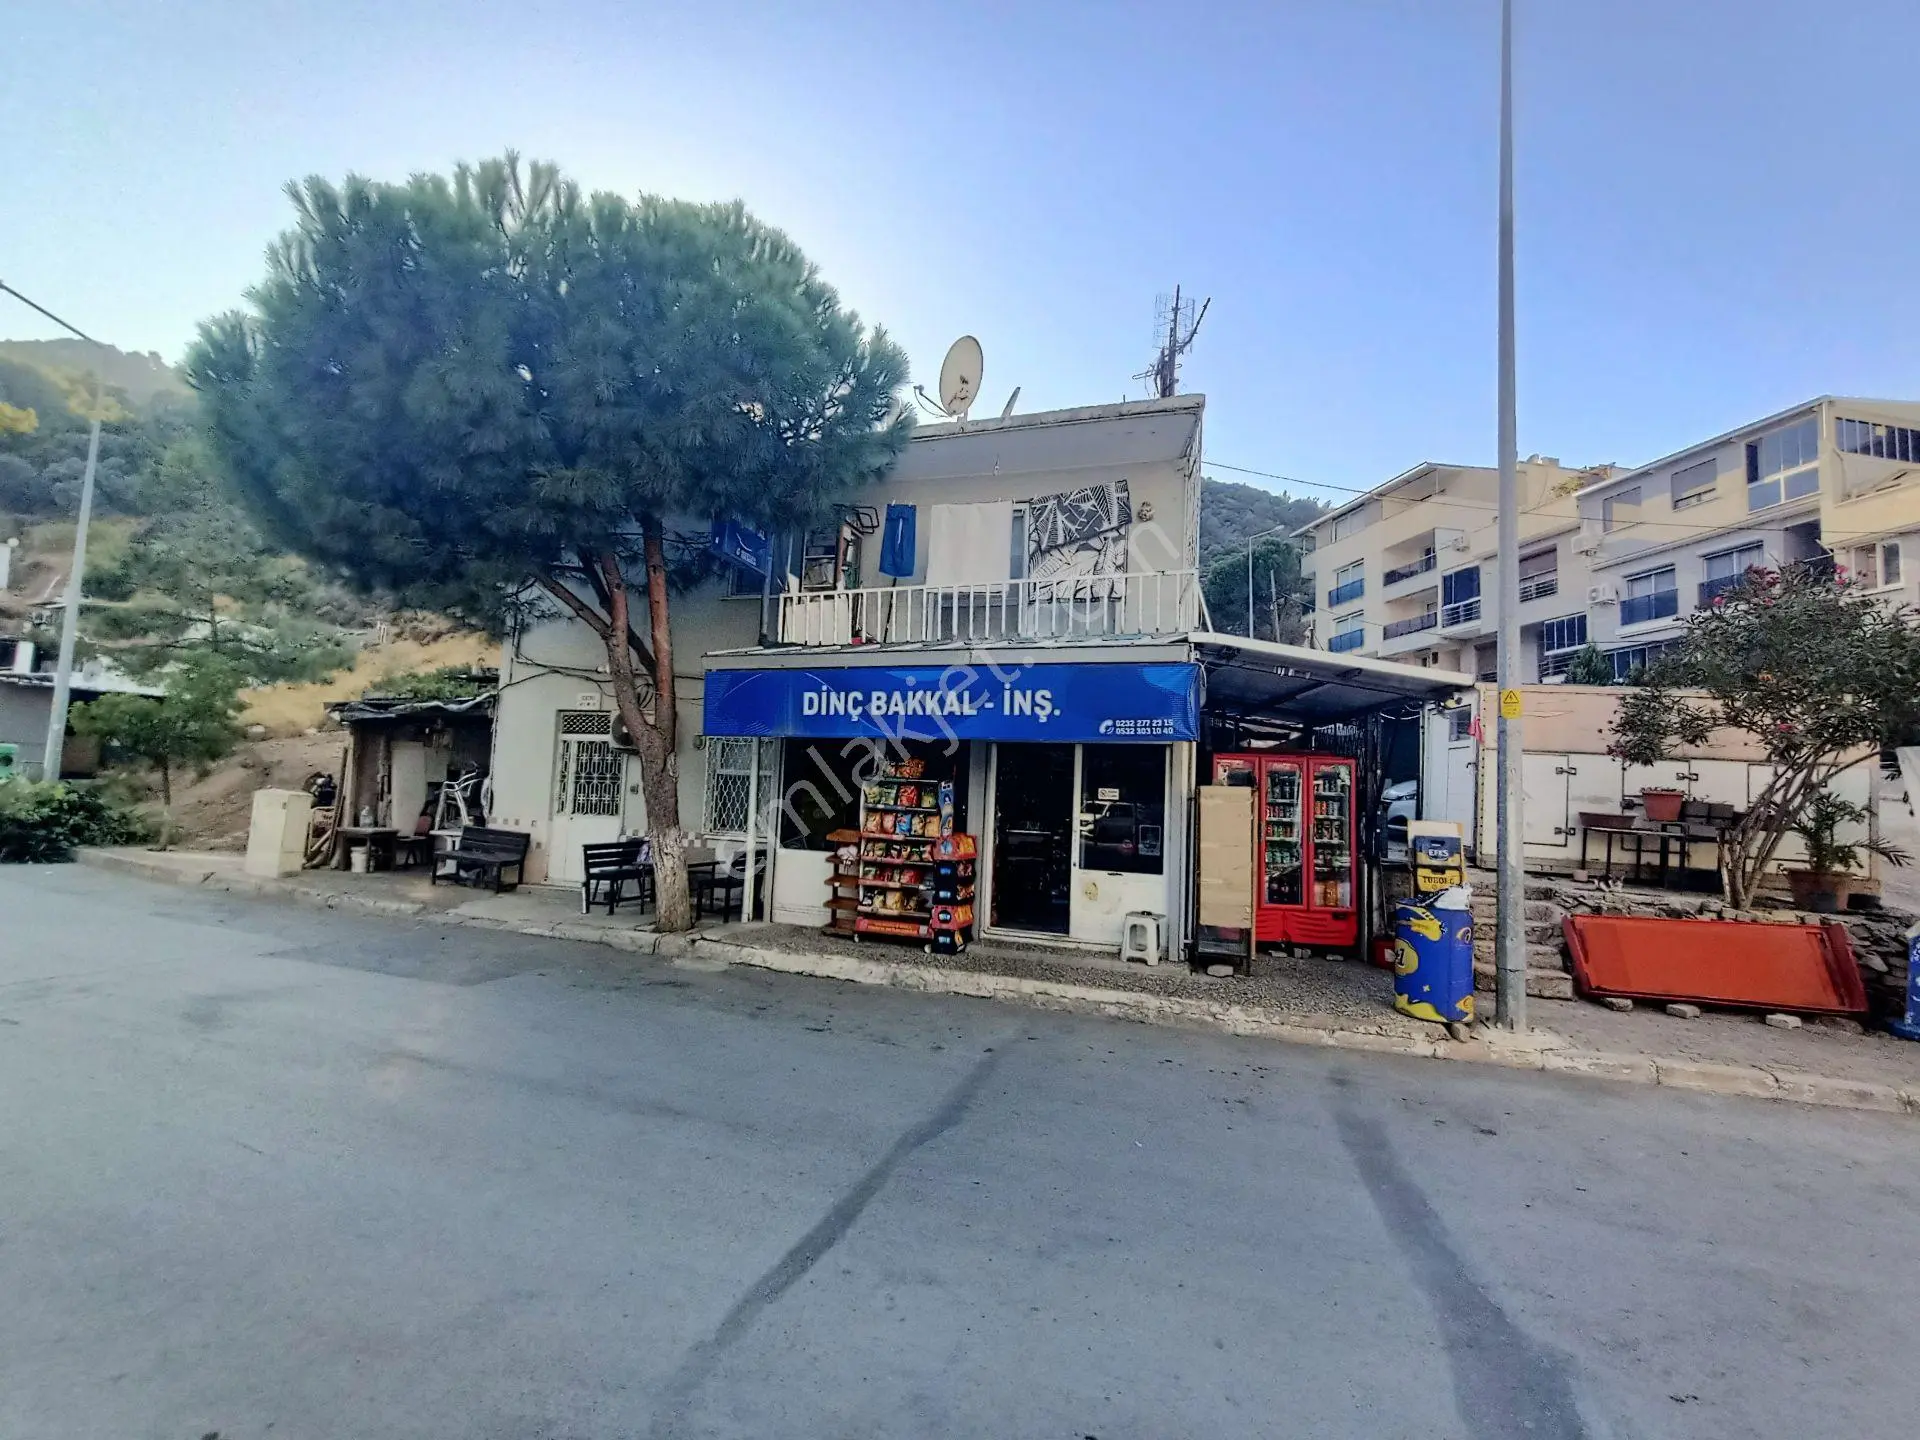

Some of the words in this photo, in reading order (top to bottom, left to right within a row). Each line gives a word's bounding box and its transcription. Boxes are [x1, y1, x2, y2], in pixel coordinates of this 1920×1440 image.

[803, 685, 863, 721] DİNÇ
[871, 689, 978, 716] BAKKAL
[1003, 683, 1061, 723] İNŞ.
[1115, 719, 1135, 727] 0232
